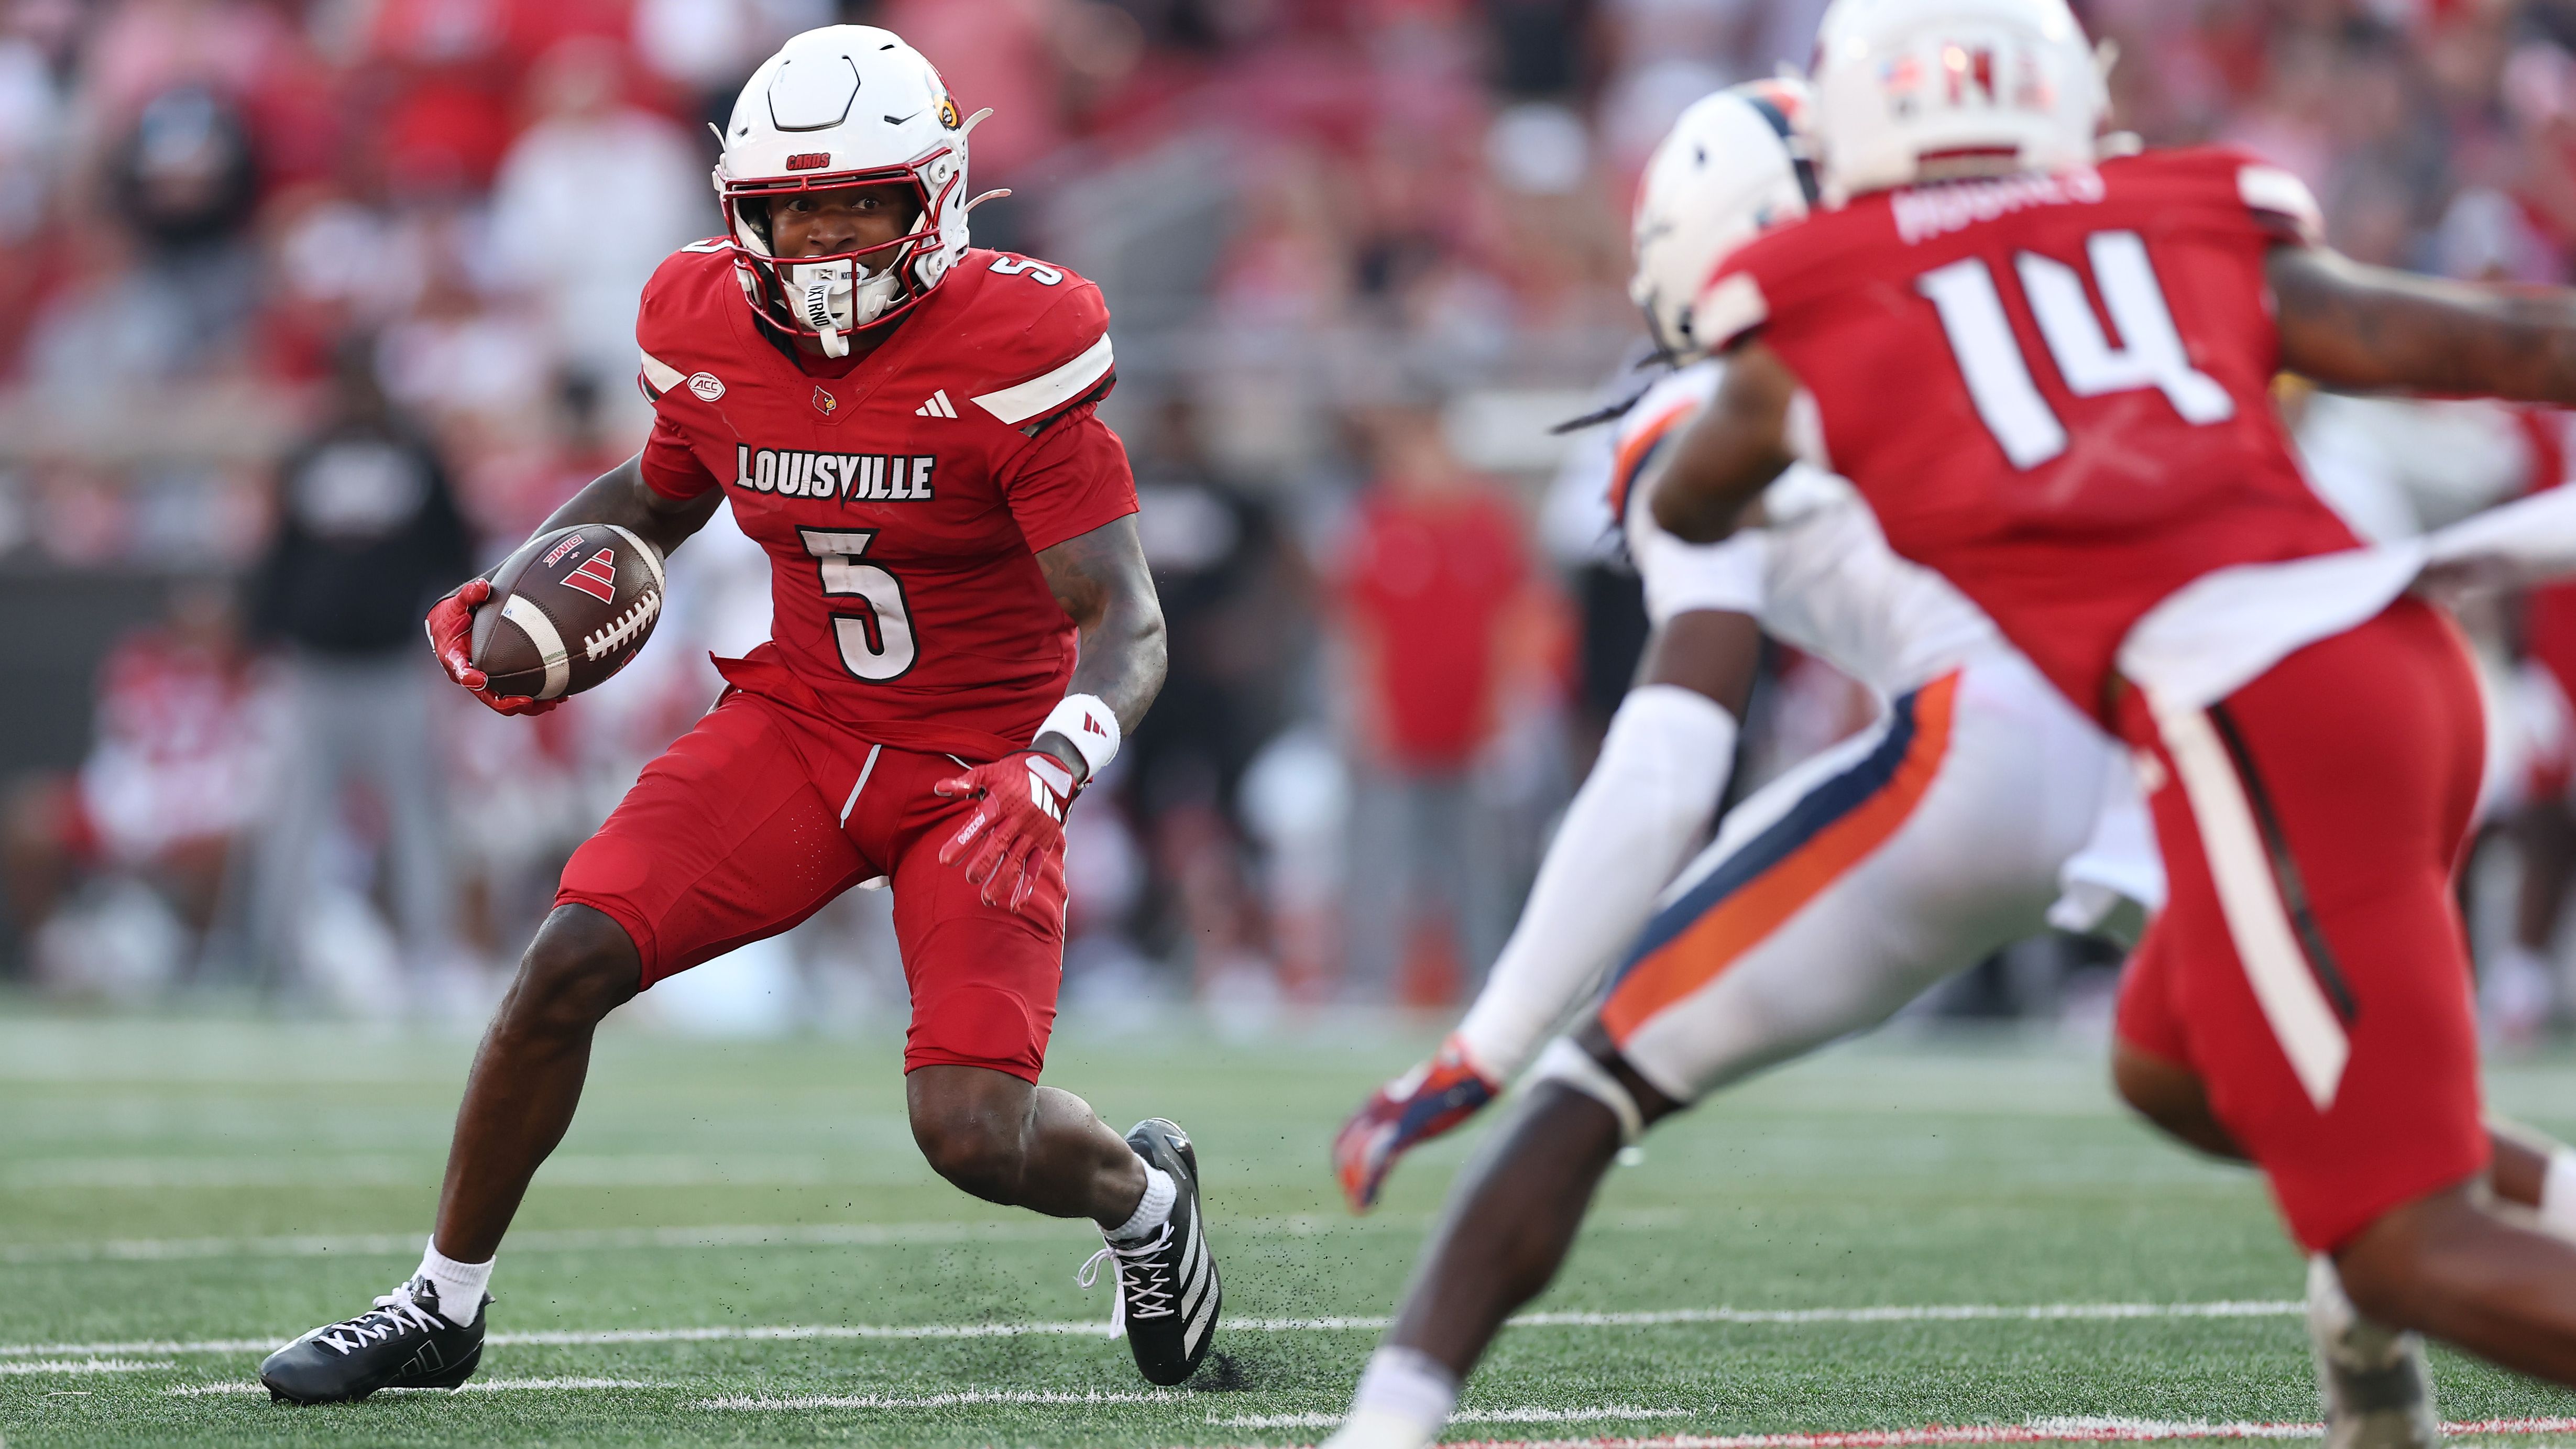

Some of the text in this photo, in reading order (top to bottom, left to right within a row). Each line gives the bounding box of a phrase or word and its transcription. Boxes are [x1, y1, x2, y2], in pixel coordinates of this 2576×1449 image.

[786, 152, 830, 171] CARDS
[988, 256, 1064, 286] 5
[808, 285, 830, 326] NXTRND
[1915, 227, 2236, 470] 14
[694, 380, 718, 391] ACC
[735, 443, 936, 508] LOUISVILLE
[542, 534, 585, 568] DIME
[794, 524, 920, 684] 5
